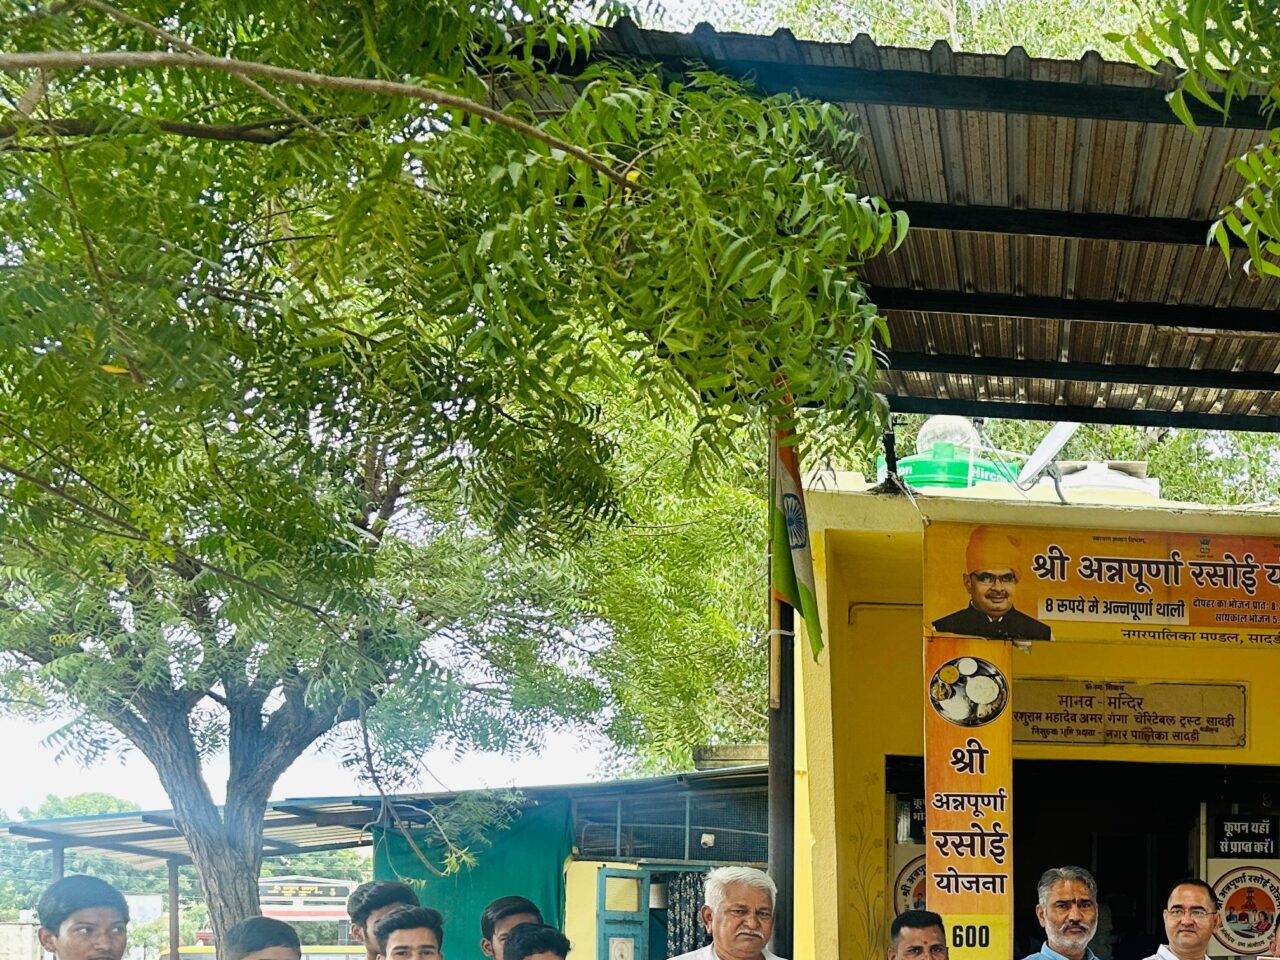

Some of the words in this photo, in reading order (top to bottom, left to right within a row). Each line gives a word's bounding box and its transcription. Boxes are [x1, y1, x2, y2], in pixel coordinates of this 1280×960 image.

[1033, 545, 1070, 580] श्री
[1078, 550, 1184, 592] अन्नपूर्णा
[1188, 553, 1259, 594] रसोई
[1045, 598, 1053, 612] 8
[1156, 599, 1185, 617] थाली
[1217, 599, 1227, 608] का
[1229, 598, 1250, 609] भोजन
[1250, 612, 1270, 624] भोजन
[1121, 628, 1197, 641] नगरपालिका
[1057, 695, 1096, 709] मानव
[1107, 693, 1144, 711] मन्दिर
[1013, 711, 1042, 726] रशुराम
[1046, 710, 1077, 723] महादेव
[1079, 713, 1103, 724] अमर
[1107, 712, 1128, 724] गंगा
[1105, 729, 1127, 740] नगर
[951, 738, 989, 774] श्री
[933, 788, 1008, 817] अन्नपूर्णा
[1224, 821, 1249, 836] कूपन
[932, 822, 1009, 864] रसोई
[1220, 840, 1228, 853] से
[1230, 841, 1251, 853] प्राप्त
[934, 867, 1008, 894] योजना
[952, 925, 990, 948] 600
